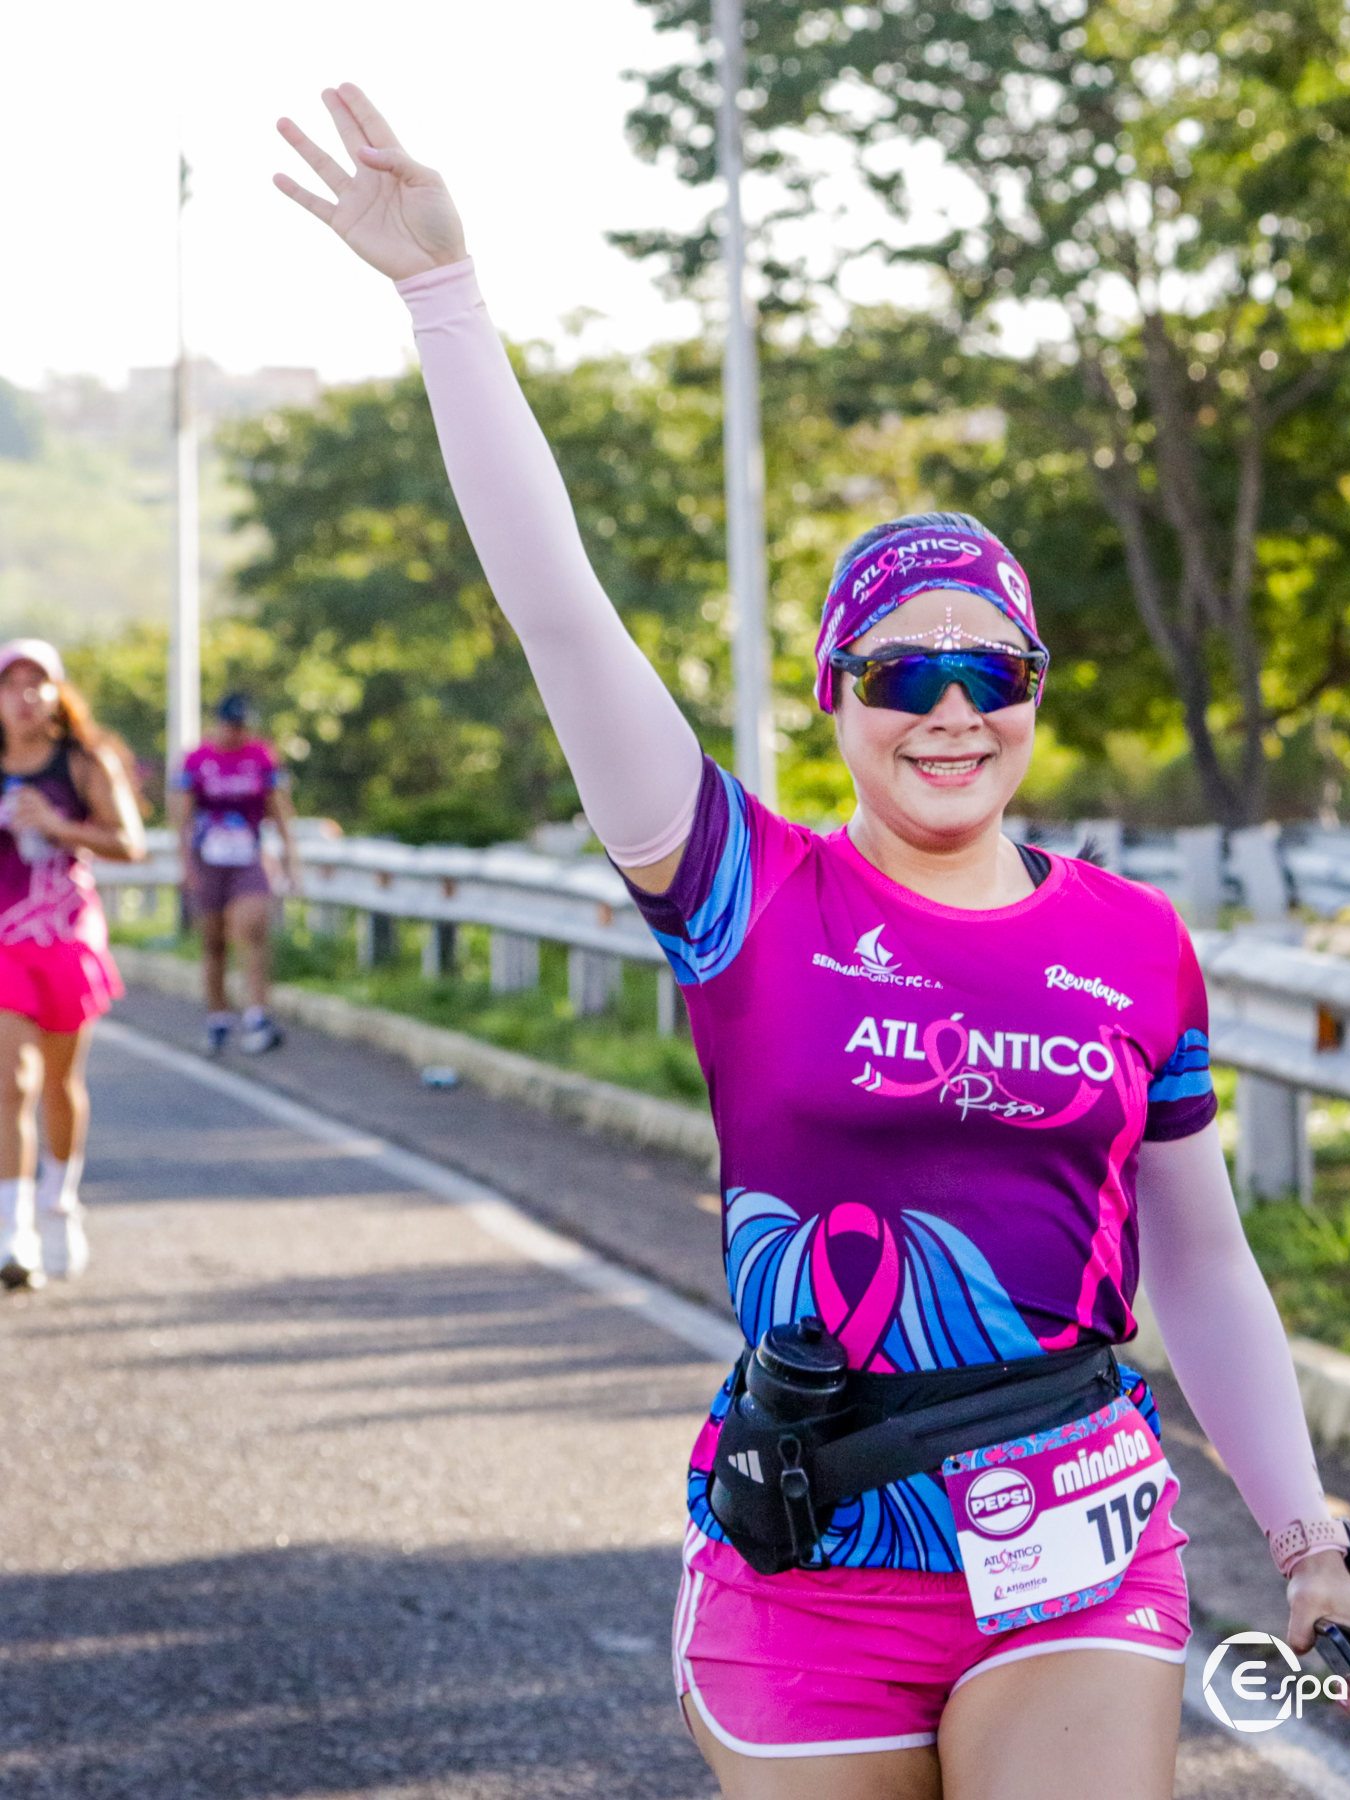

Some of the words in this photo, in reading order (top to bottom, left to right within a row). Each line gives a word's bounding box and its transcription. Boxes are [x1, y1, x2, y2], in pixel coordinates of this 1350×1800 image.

[940, 1073, 1045, 1122] Rosa
[1053, 1429, 1152, 1498] minalba
[971, 1487, 1030, 1515] PEPSI
